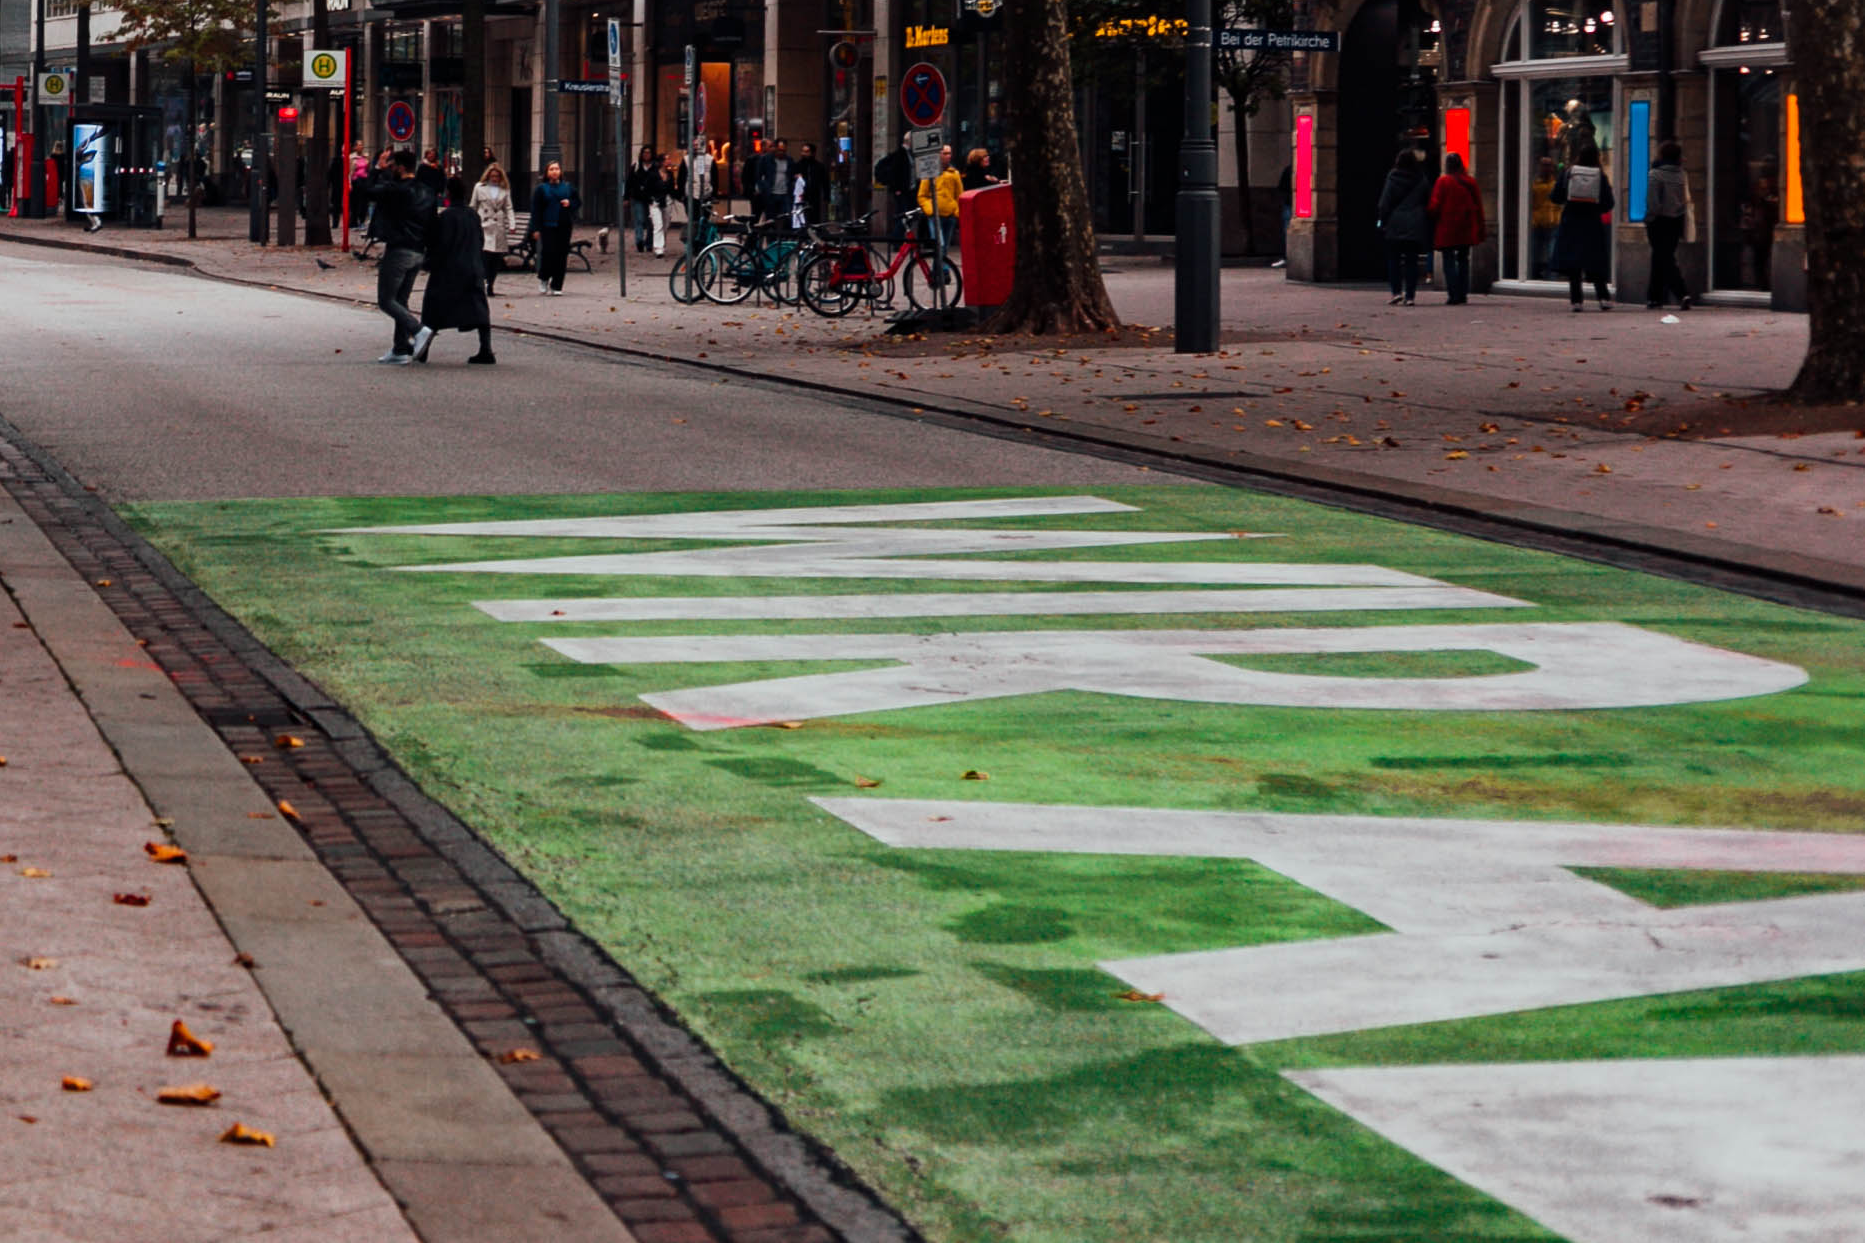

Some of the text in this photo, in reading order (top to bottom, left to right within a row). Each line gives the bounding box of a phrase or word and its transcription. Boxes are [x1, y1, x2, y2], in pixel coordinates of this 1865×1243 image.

[1221, 32, 1331, 48] Bei der Petrikirche
[564, 82, 610, 93] Kreuslerstra
